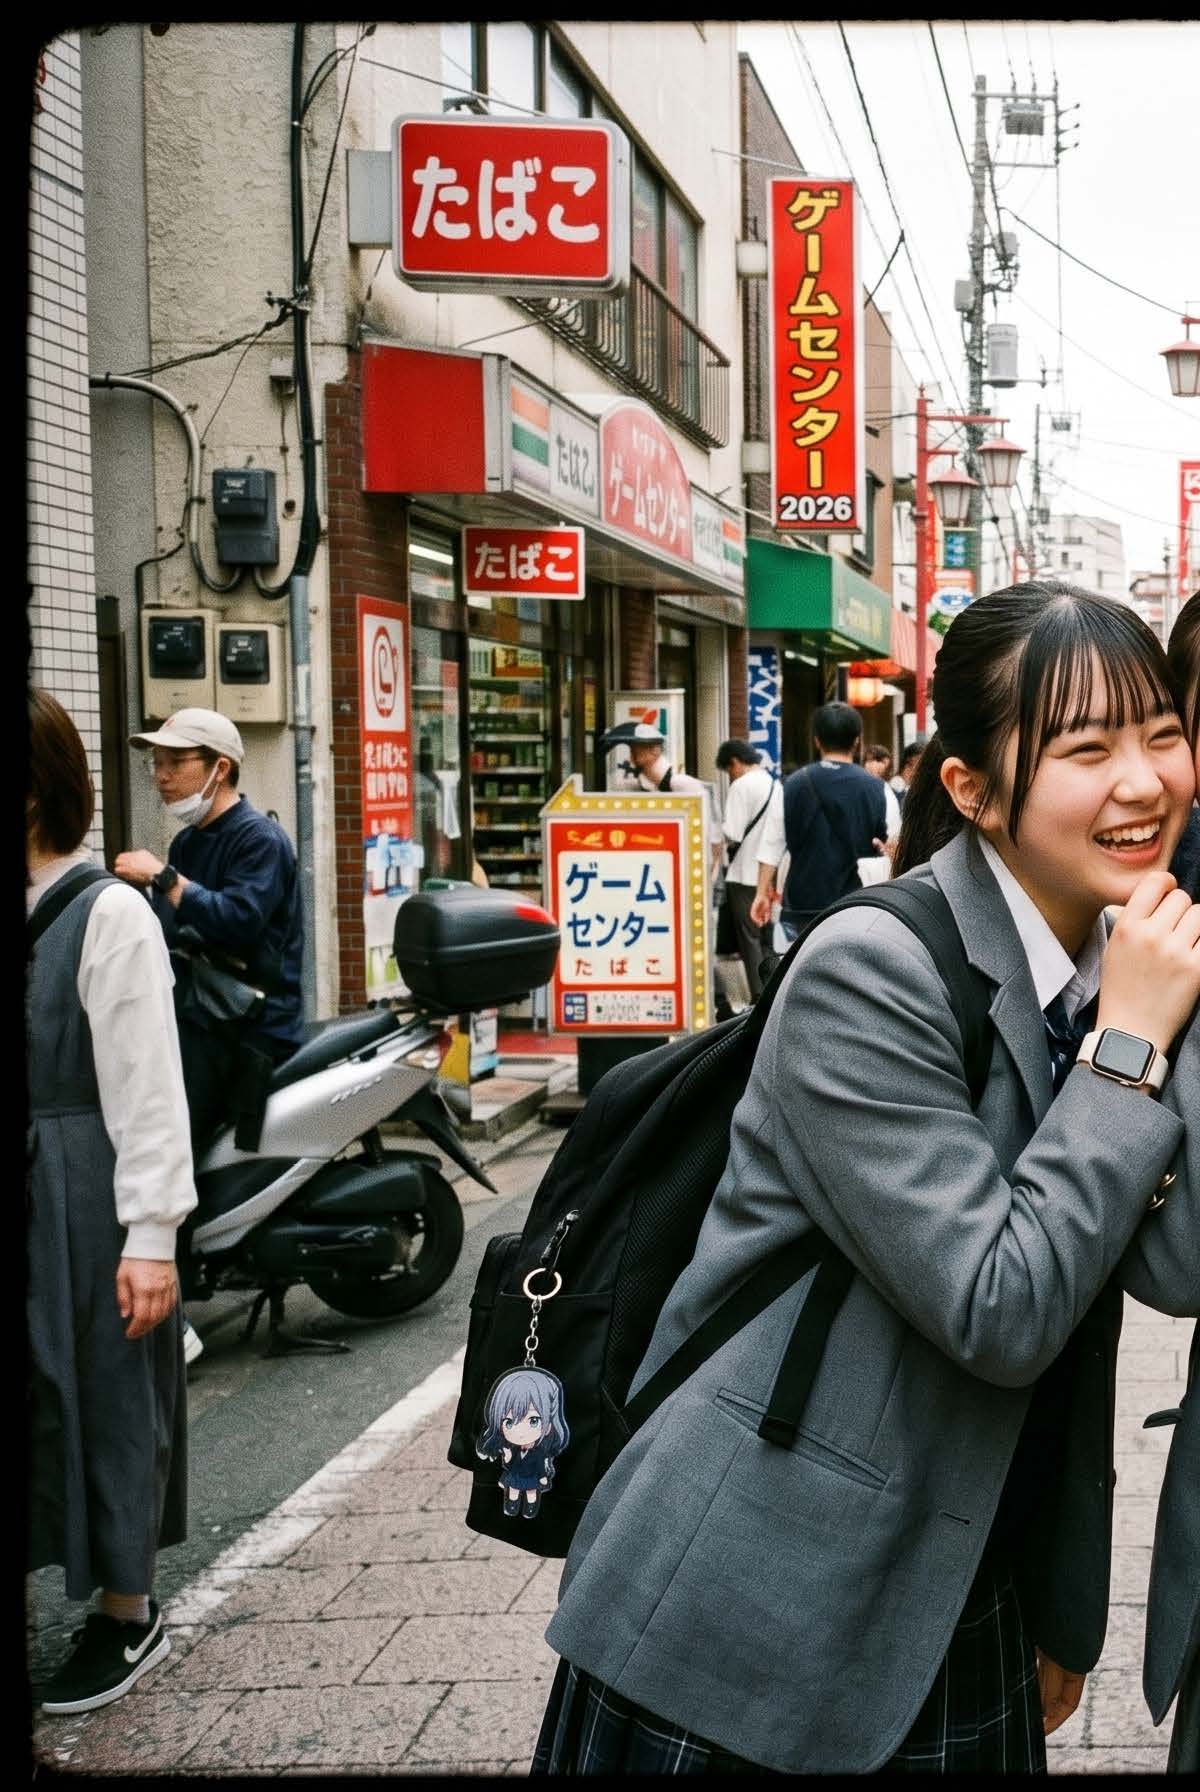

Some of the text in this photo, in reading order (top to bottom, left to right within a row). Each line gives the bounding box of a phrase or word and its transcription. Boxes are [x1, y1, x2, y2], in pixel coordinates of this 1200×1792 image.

[411, 156, 600, 244] たばこ
[788, 188, 841, 490] ゲームセンター
[779, 495, 853, 522] 2026
[474, 541, 576, 581] たばこ
[565, 862, 667, 904] ゲーム
[567, 911, 670, 948] センター
[574, 957, 662, 977] たばこ
